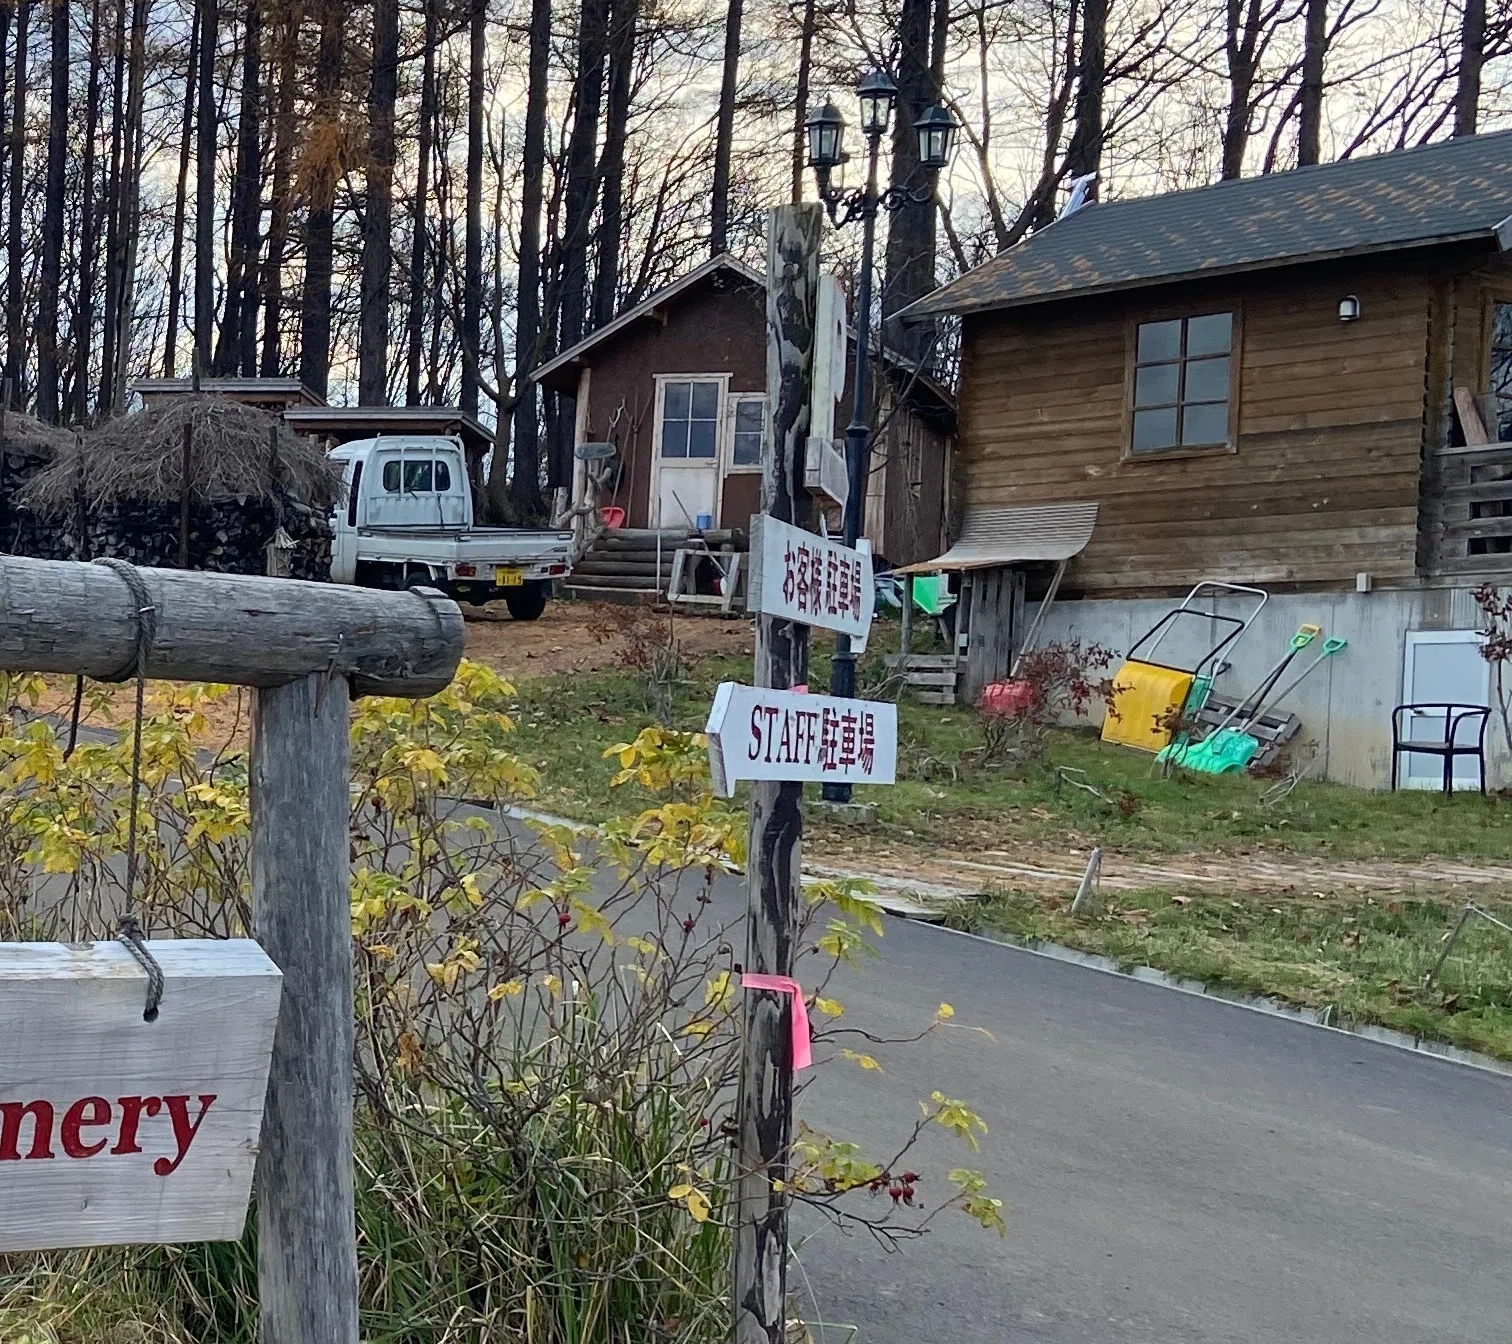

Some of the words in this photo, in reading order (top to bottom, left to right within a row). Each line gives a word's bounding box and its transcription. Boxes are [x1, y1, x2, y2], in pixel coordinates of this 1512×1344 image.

[782, 539, 862, 623] お客様駐車場
